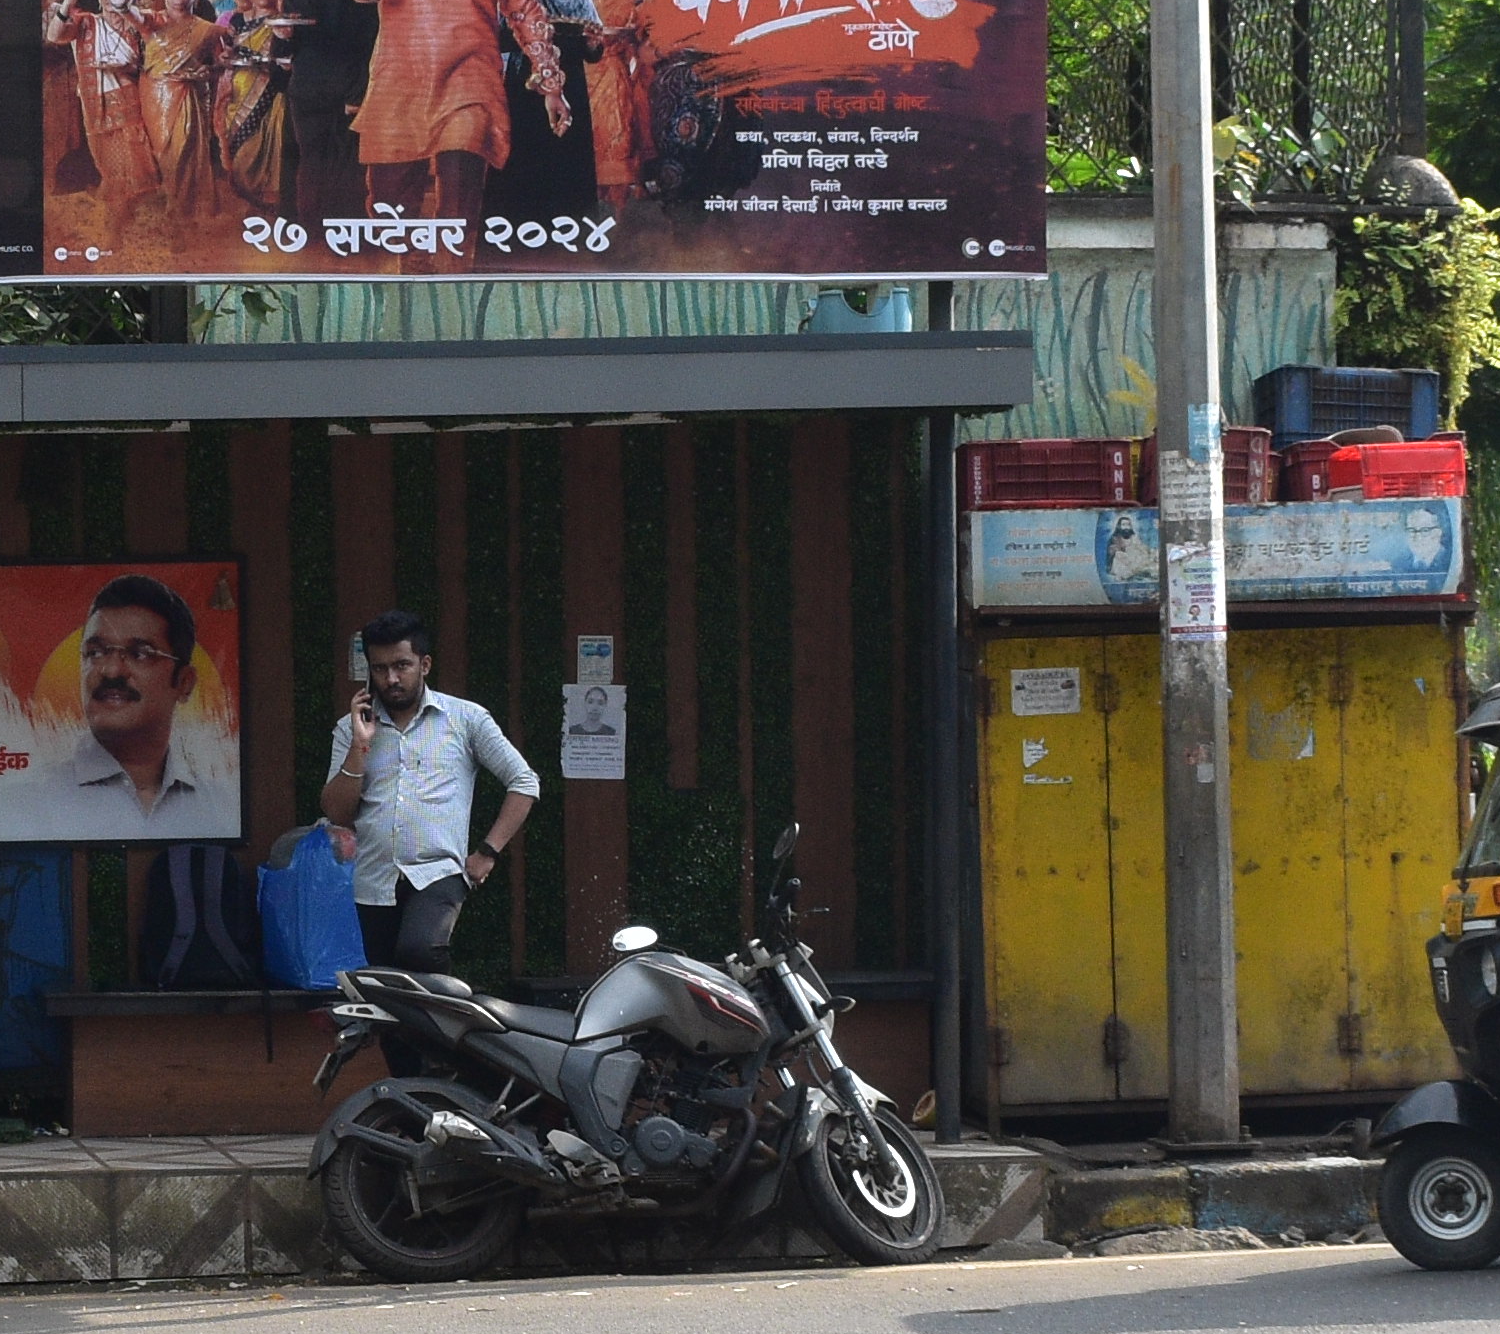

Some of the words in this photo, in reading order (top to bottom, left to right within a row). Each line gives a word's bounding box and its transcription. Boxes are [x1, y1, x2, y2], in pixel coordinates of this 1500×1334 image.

[868, 18, 920, 58] ठाणे
[734, 91, 807, 117] साहेबांच्या
[816, 90, 886, 118] हिंदुत्वाची
[870, 127, 919, 143] दिग्दर्शन
[761, 149, 802, 169] प्रविण
[854, 148, 888, 169] तरडे
[704, 195, 738, 212] मंगेश
[742, 195, 778, 212] जीवन
[782, 195, 820, 213] देसाई
[832, 195, 863, 211] उमेश
[867, 199, 904, 215] कुमार
[242, 216, 308, 252] २७
[322, 202, 467, 256] सप्टेंबर
[484, 216, 617, 252] २०२४
